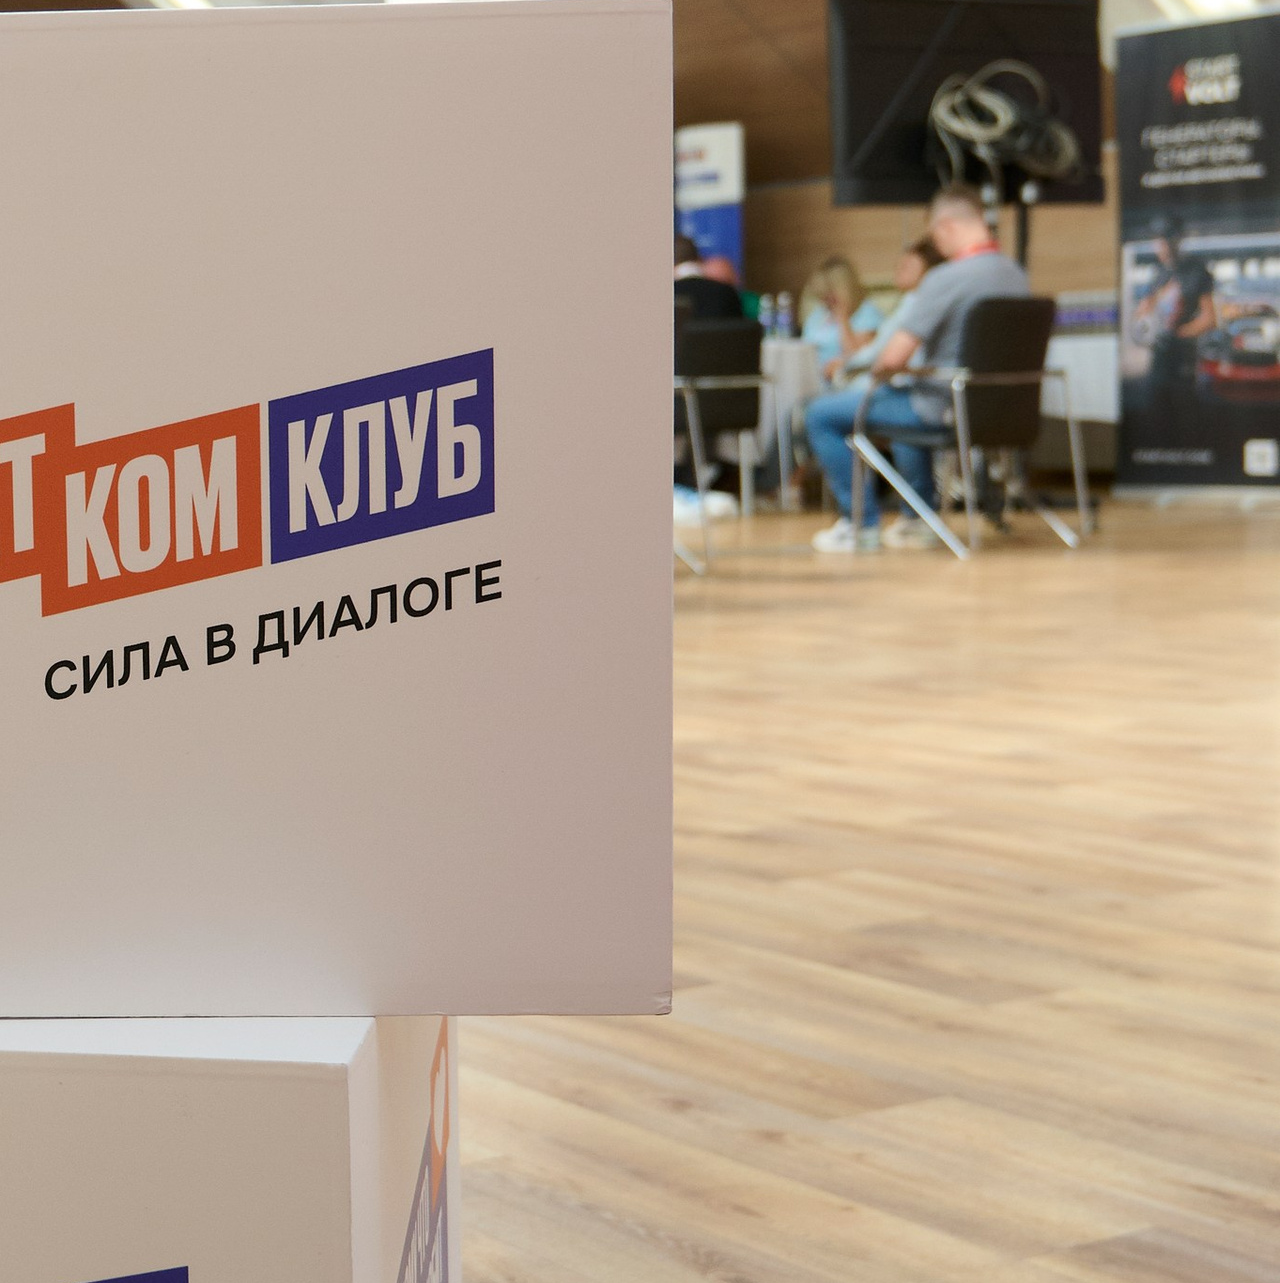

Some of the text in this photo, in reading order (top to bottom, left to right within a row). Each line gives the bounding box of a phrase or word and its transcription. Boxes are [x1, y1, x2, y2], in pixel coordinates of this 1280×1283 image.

[287, 378, 483, 534] КЛУБ
[44, 559, 503, 700] СИЛА В ДИАЛОГЕ
[417, 1164, 429, 1277] ЧТО
